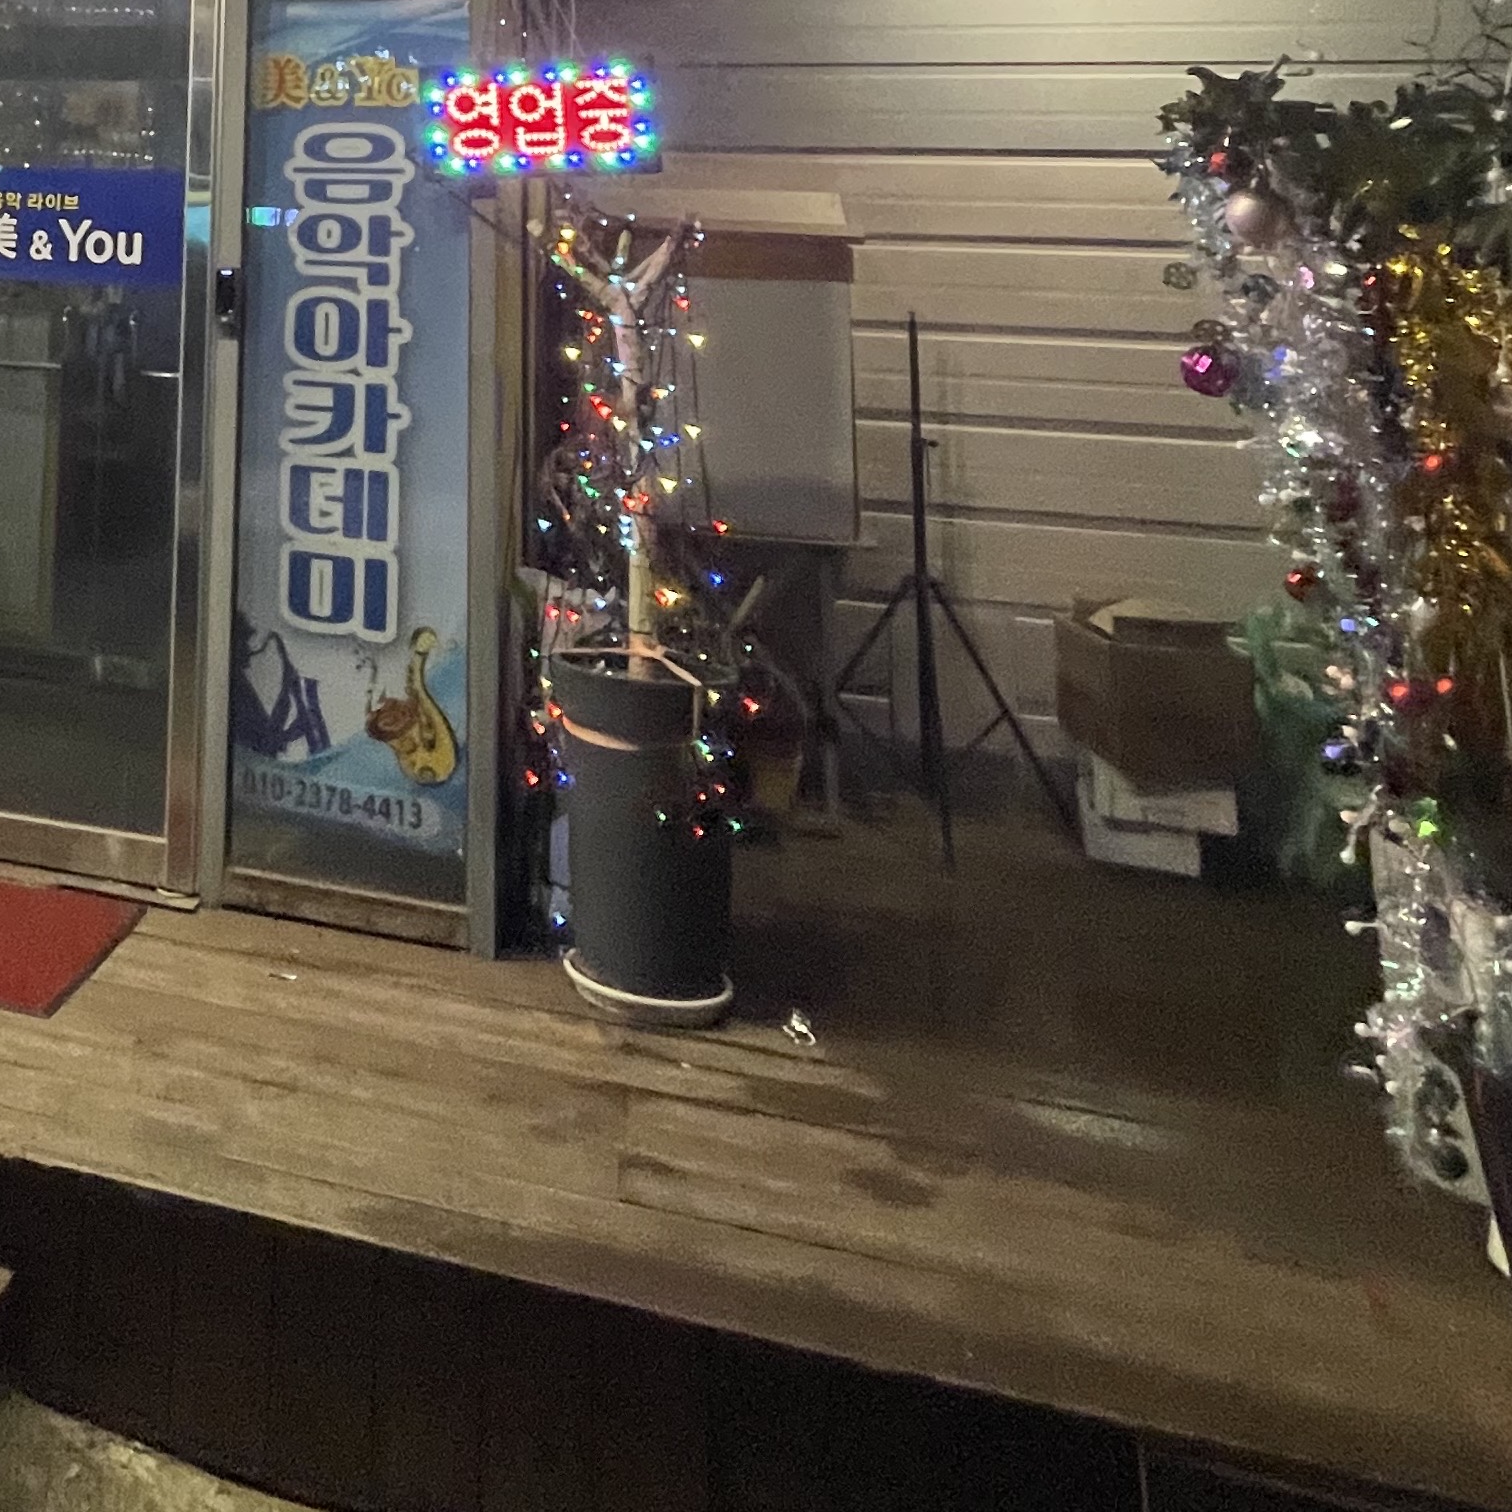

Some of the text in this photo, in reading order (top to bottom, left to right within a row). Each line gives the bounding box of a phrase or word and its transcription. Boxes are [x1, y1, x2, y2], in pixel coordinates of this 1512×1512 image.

[445, 77, 632, 159] 영업중
[27, 192, 80, 211] 라이브
[29, 230, 53, 260] &
[58, 219, 143, 265] You
[282, 123, 414, 645] 음악아카데미
